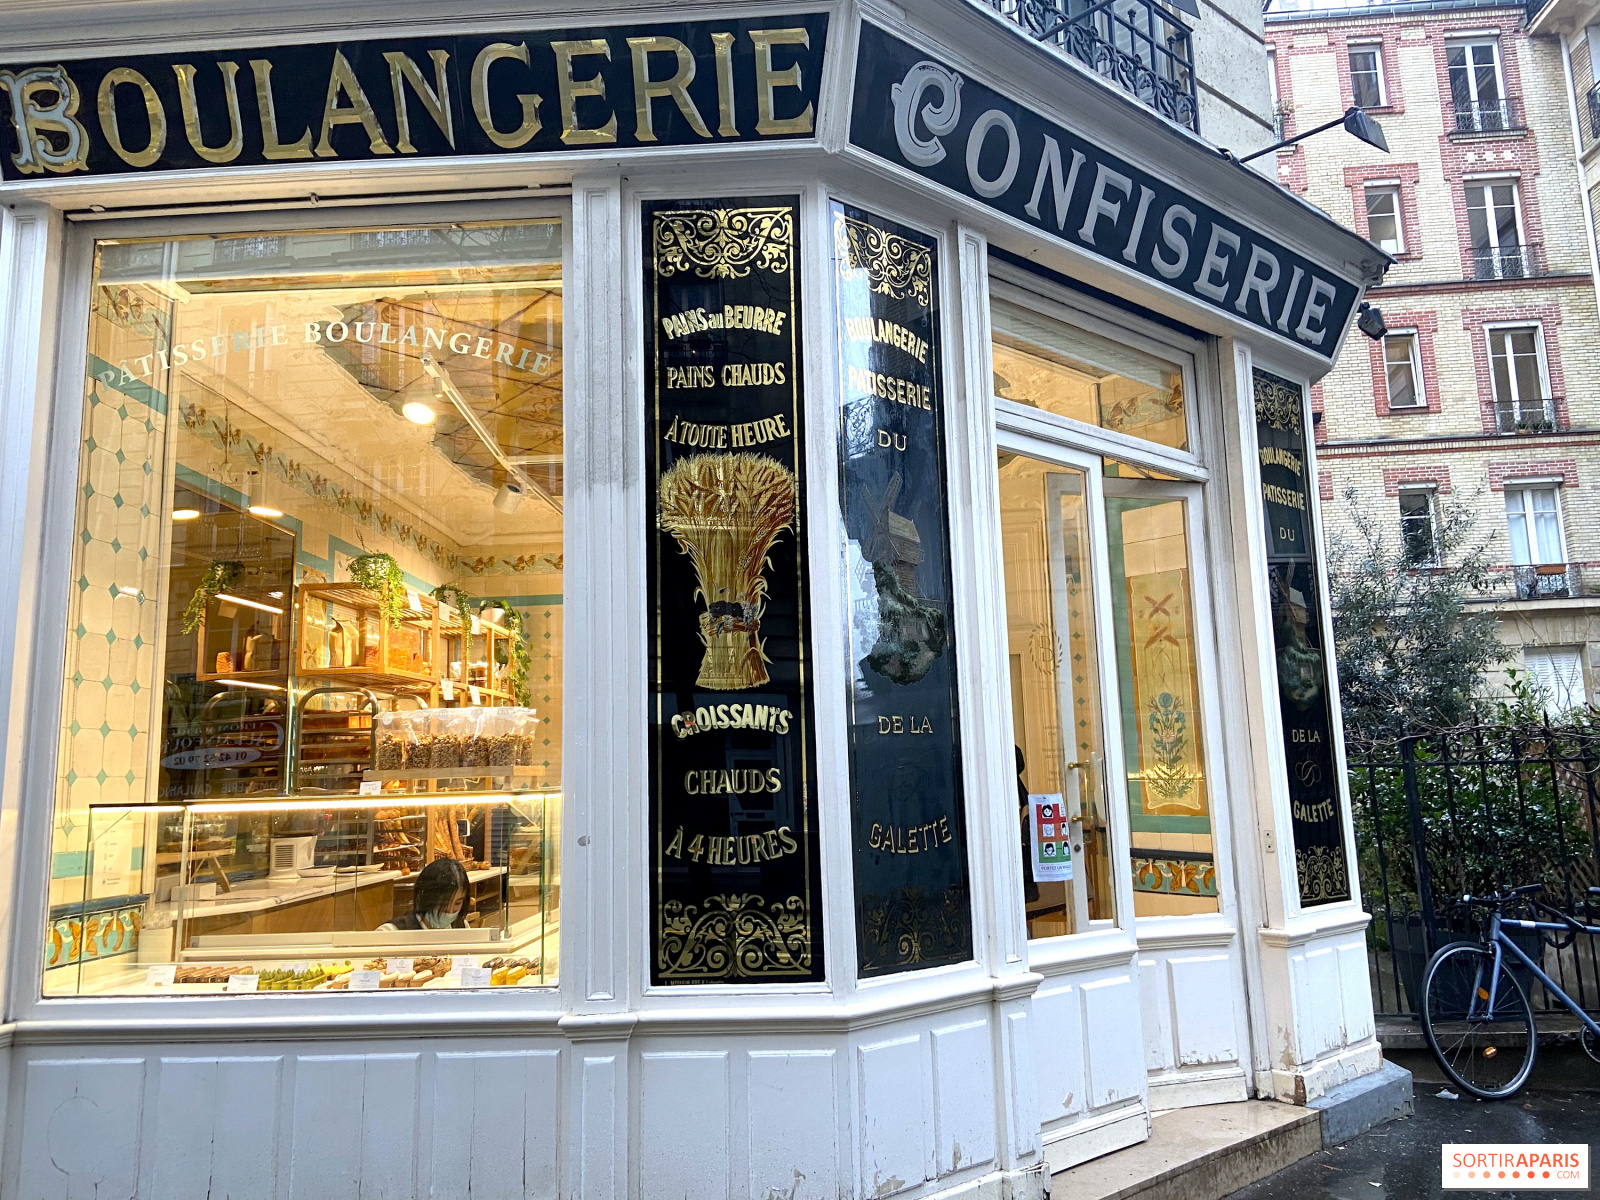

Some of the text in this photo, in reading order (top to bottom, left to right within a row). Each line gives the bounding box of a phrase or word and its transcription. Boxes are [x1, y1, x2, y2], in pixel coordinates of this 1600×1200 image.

[0, 27, 815, 175] BOULANGERIE
[890, 60, 1337, 346] CONFISERIE
[661, 304, 787, 340] PAINS au BEURRE
[97, 320, 554, 392] PÂTISSERIE BOULANGERIE
[845, 316, 929, 365] BOULANGERIE
[666, 362, 786, 389] PAINS CHAUDS
[848, 365, 931, 411] PATISSERIE
[663, 413, 790, 448] À TOUTE HEURE
[877, 429, 907, 452] DU
[1258, 446, 1302, 477] BOULANGERIE
[1262, 482, 1305, 511] PATISSERIE
[1279, 526, 1295, 542] DU
[671, 703, 794, 739] CROISSANTS
[878, 715, 933, 734] DE LA
[1292, 728, 1321, 743] DE LA
[685, 767, 782, 795] CHAUDS
[1292, 798, 1335, 823] GALETTE
[665, 825, 798, 866] À 4 HEURES
[868, 814, 953, 855] GALETTE
